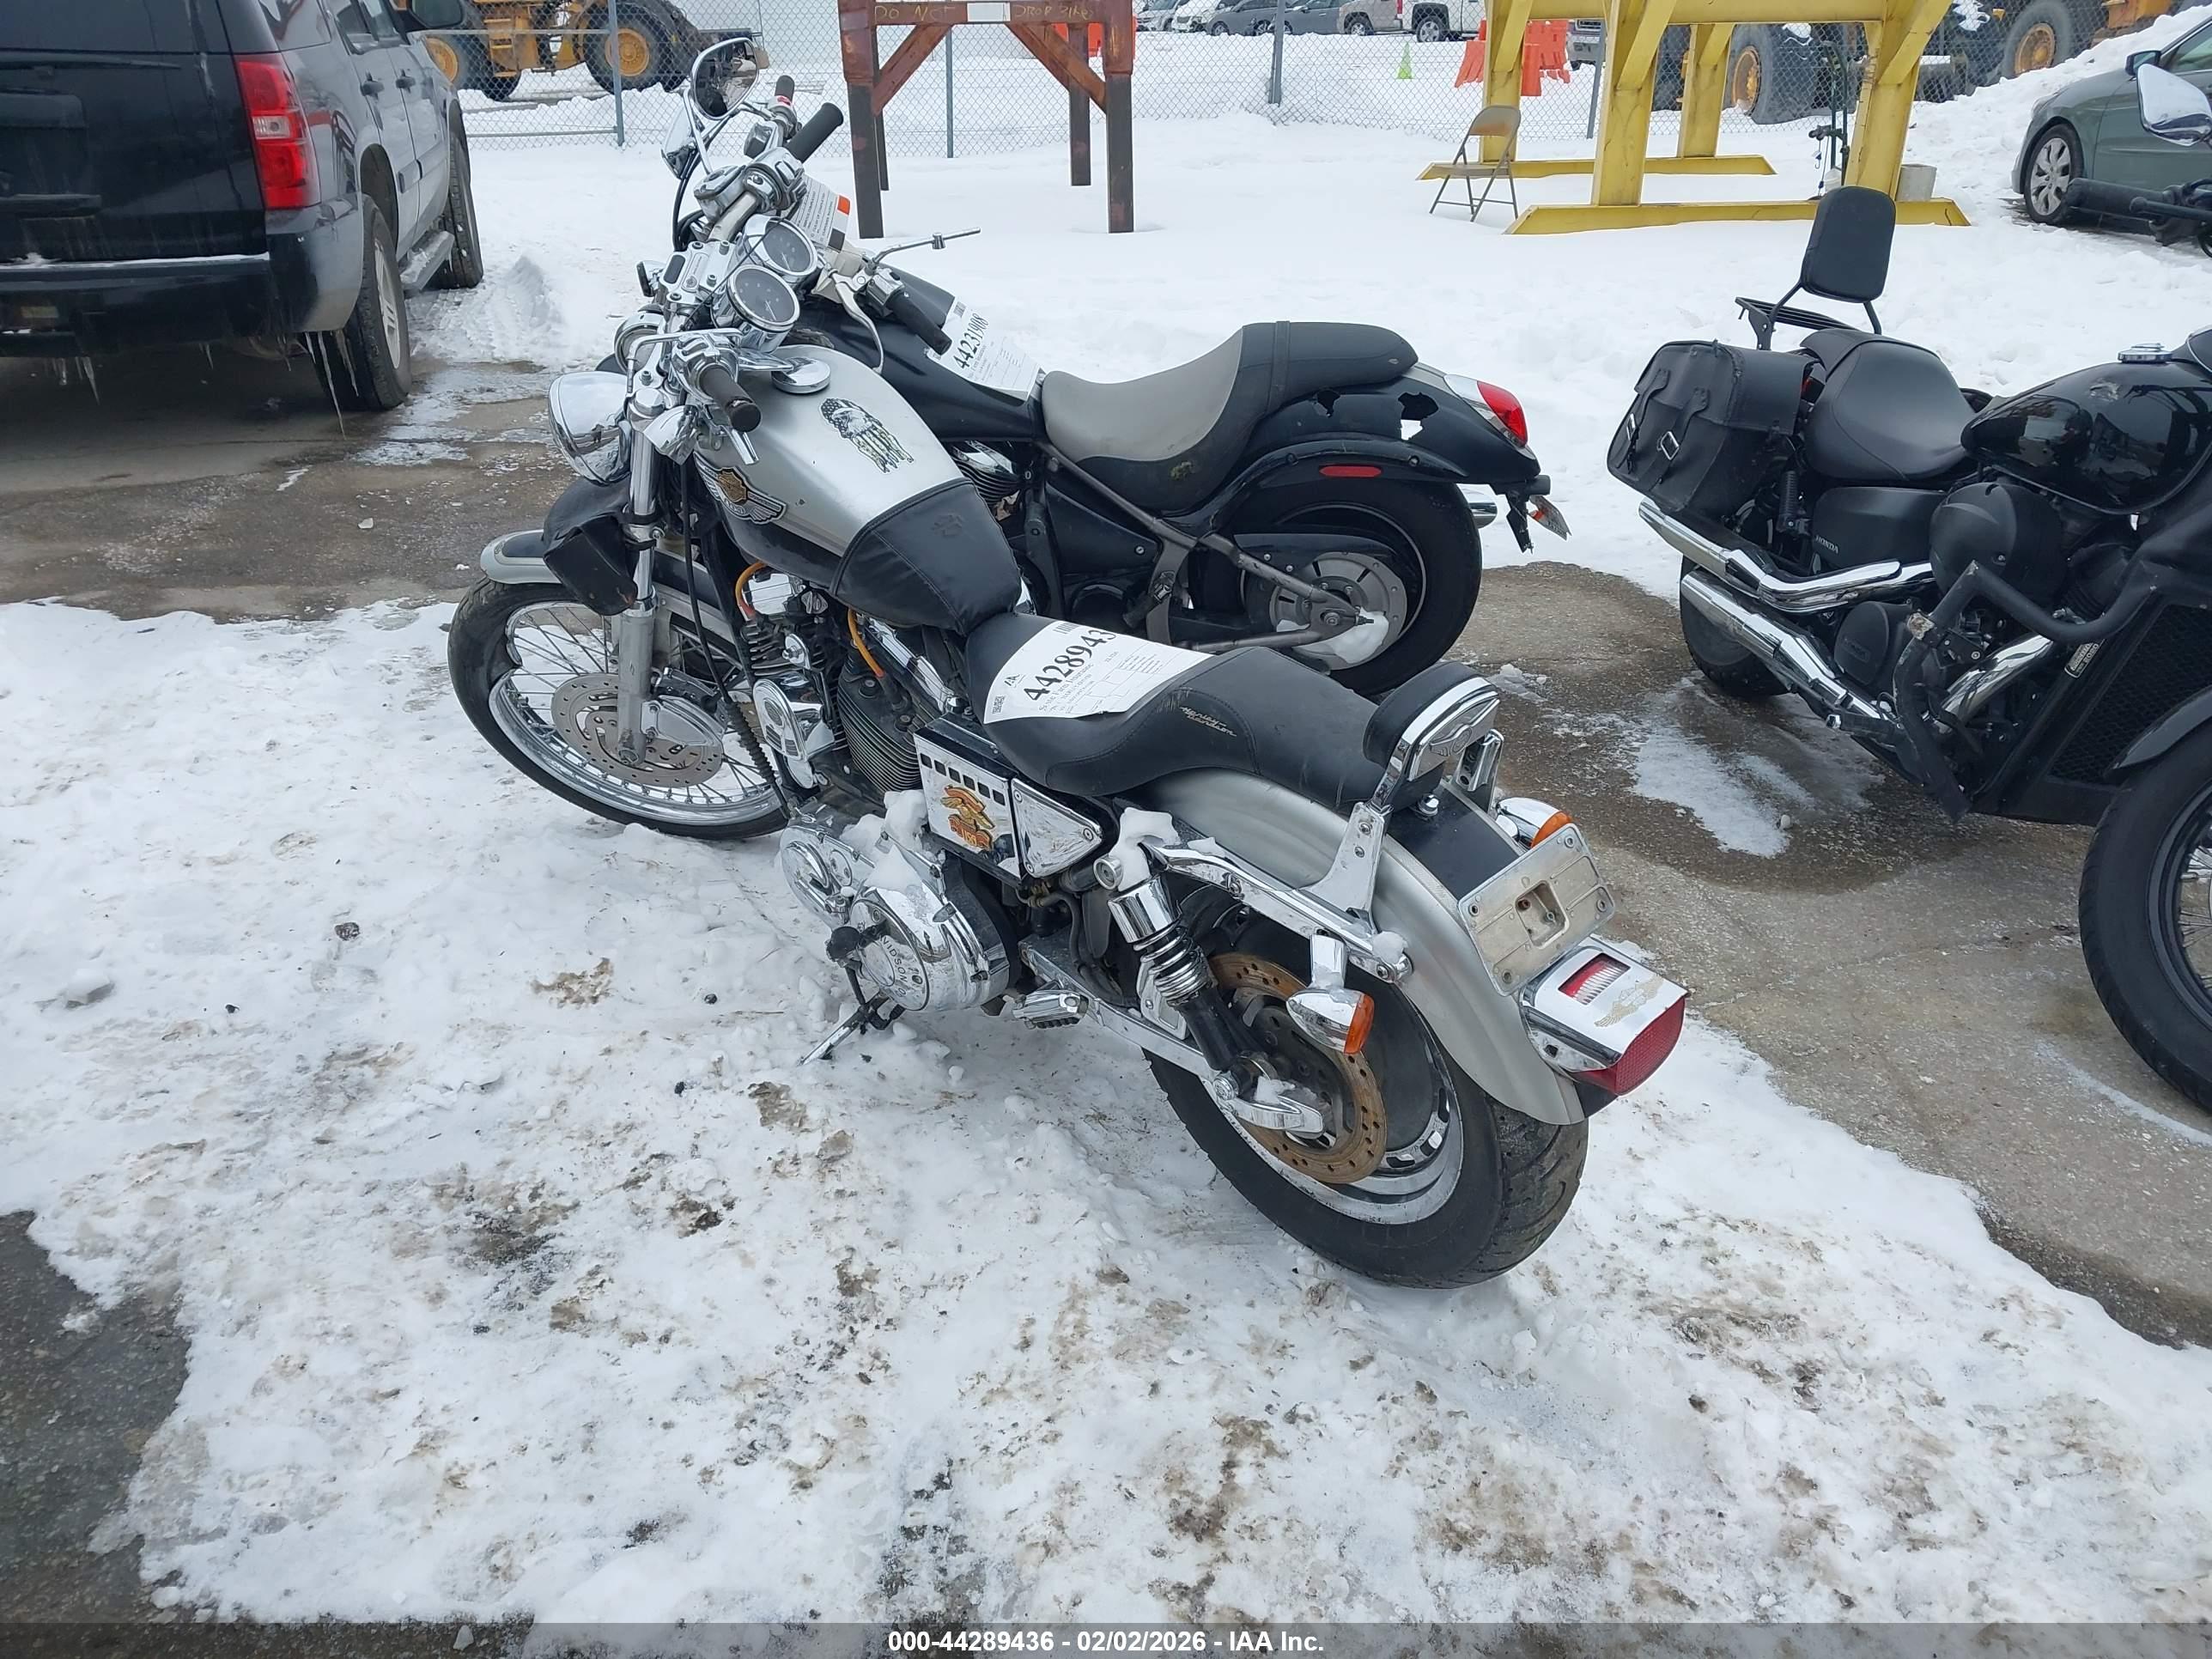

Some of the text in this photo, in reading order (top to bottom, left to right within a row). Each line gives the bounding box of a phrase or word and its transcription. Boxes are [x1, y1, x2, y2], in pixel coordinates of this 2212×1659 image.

[874, 5, 899, 21] DO
[1013, 4, 1052, 17] DROP
[953, 313, 988, 369] 44231908
[1815, 535, 1838, 554] HONDA
